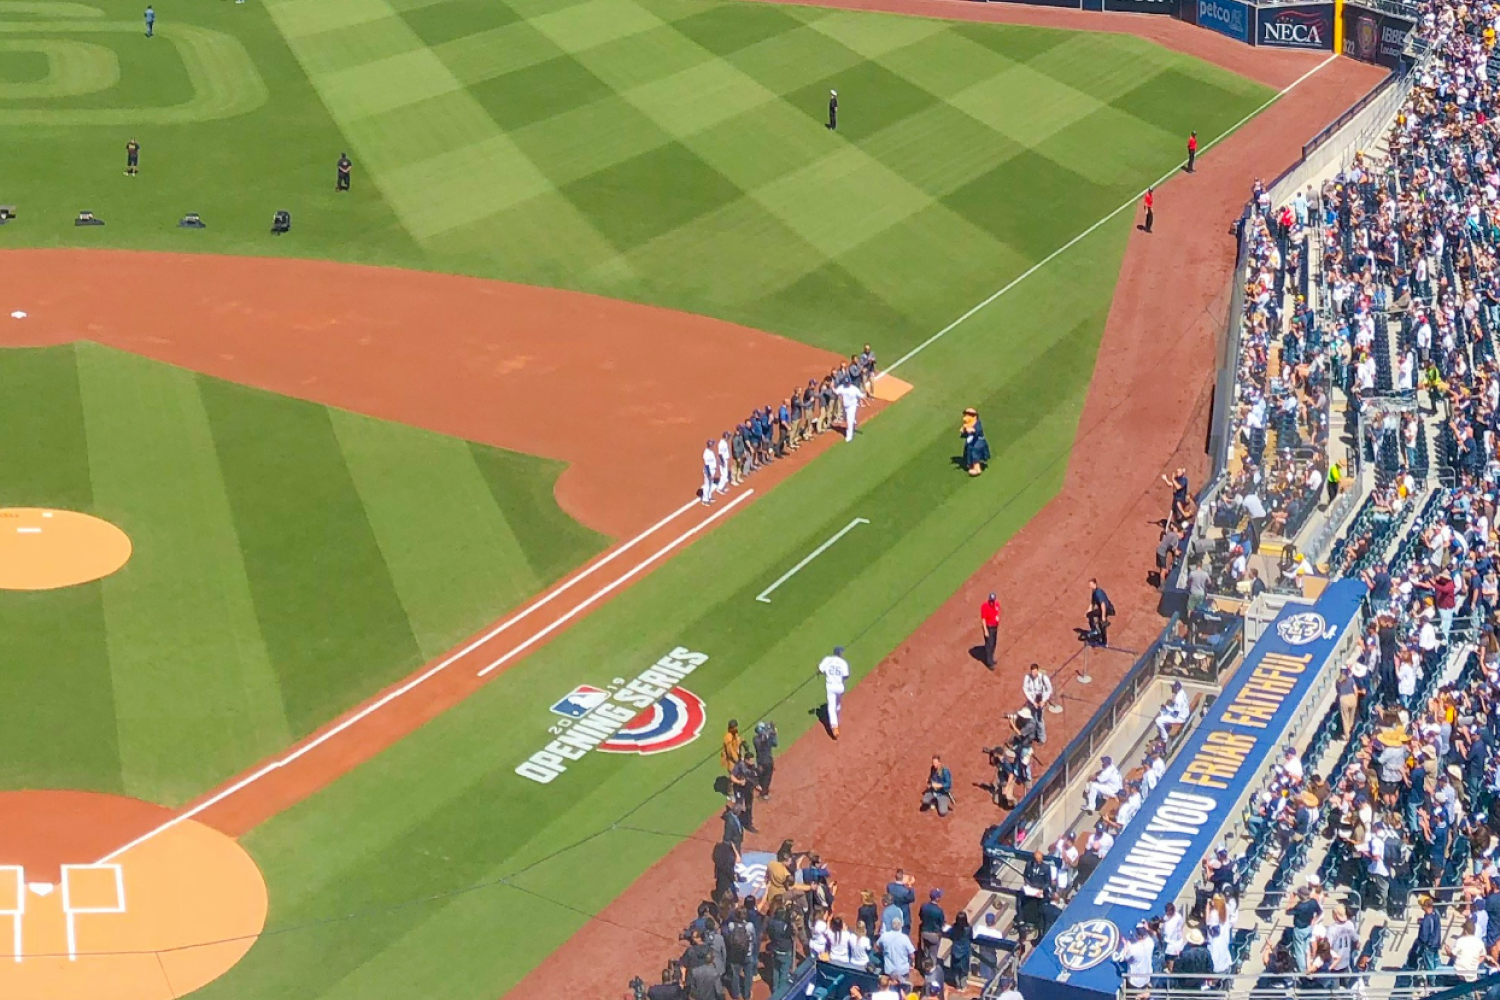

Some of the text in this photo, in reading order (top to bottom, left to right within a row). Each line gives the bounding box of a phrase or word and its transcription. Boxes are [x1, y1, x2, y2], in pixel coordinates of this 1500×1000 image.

[1200, 1, 1230, 24] petco
[1264, 21, 1322, 43] NECA
[515, 646, 709, 784] OPENING SERIES
[1093, 652, 1313, 911] THANK YOU FRIAR FAITHFUL
